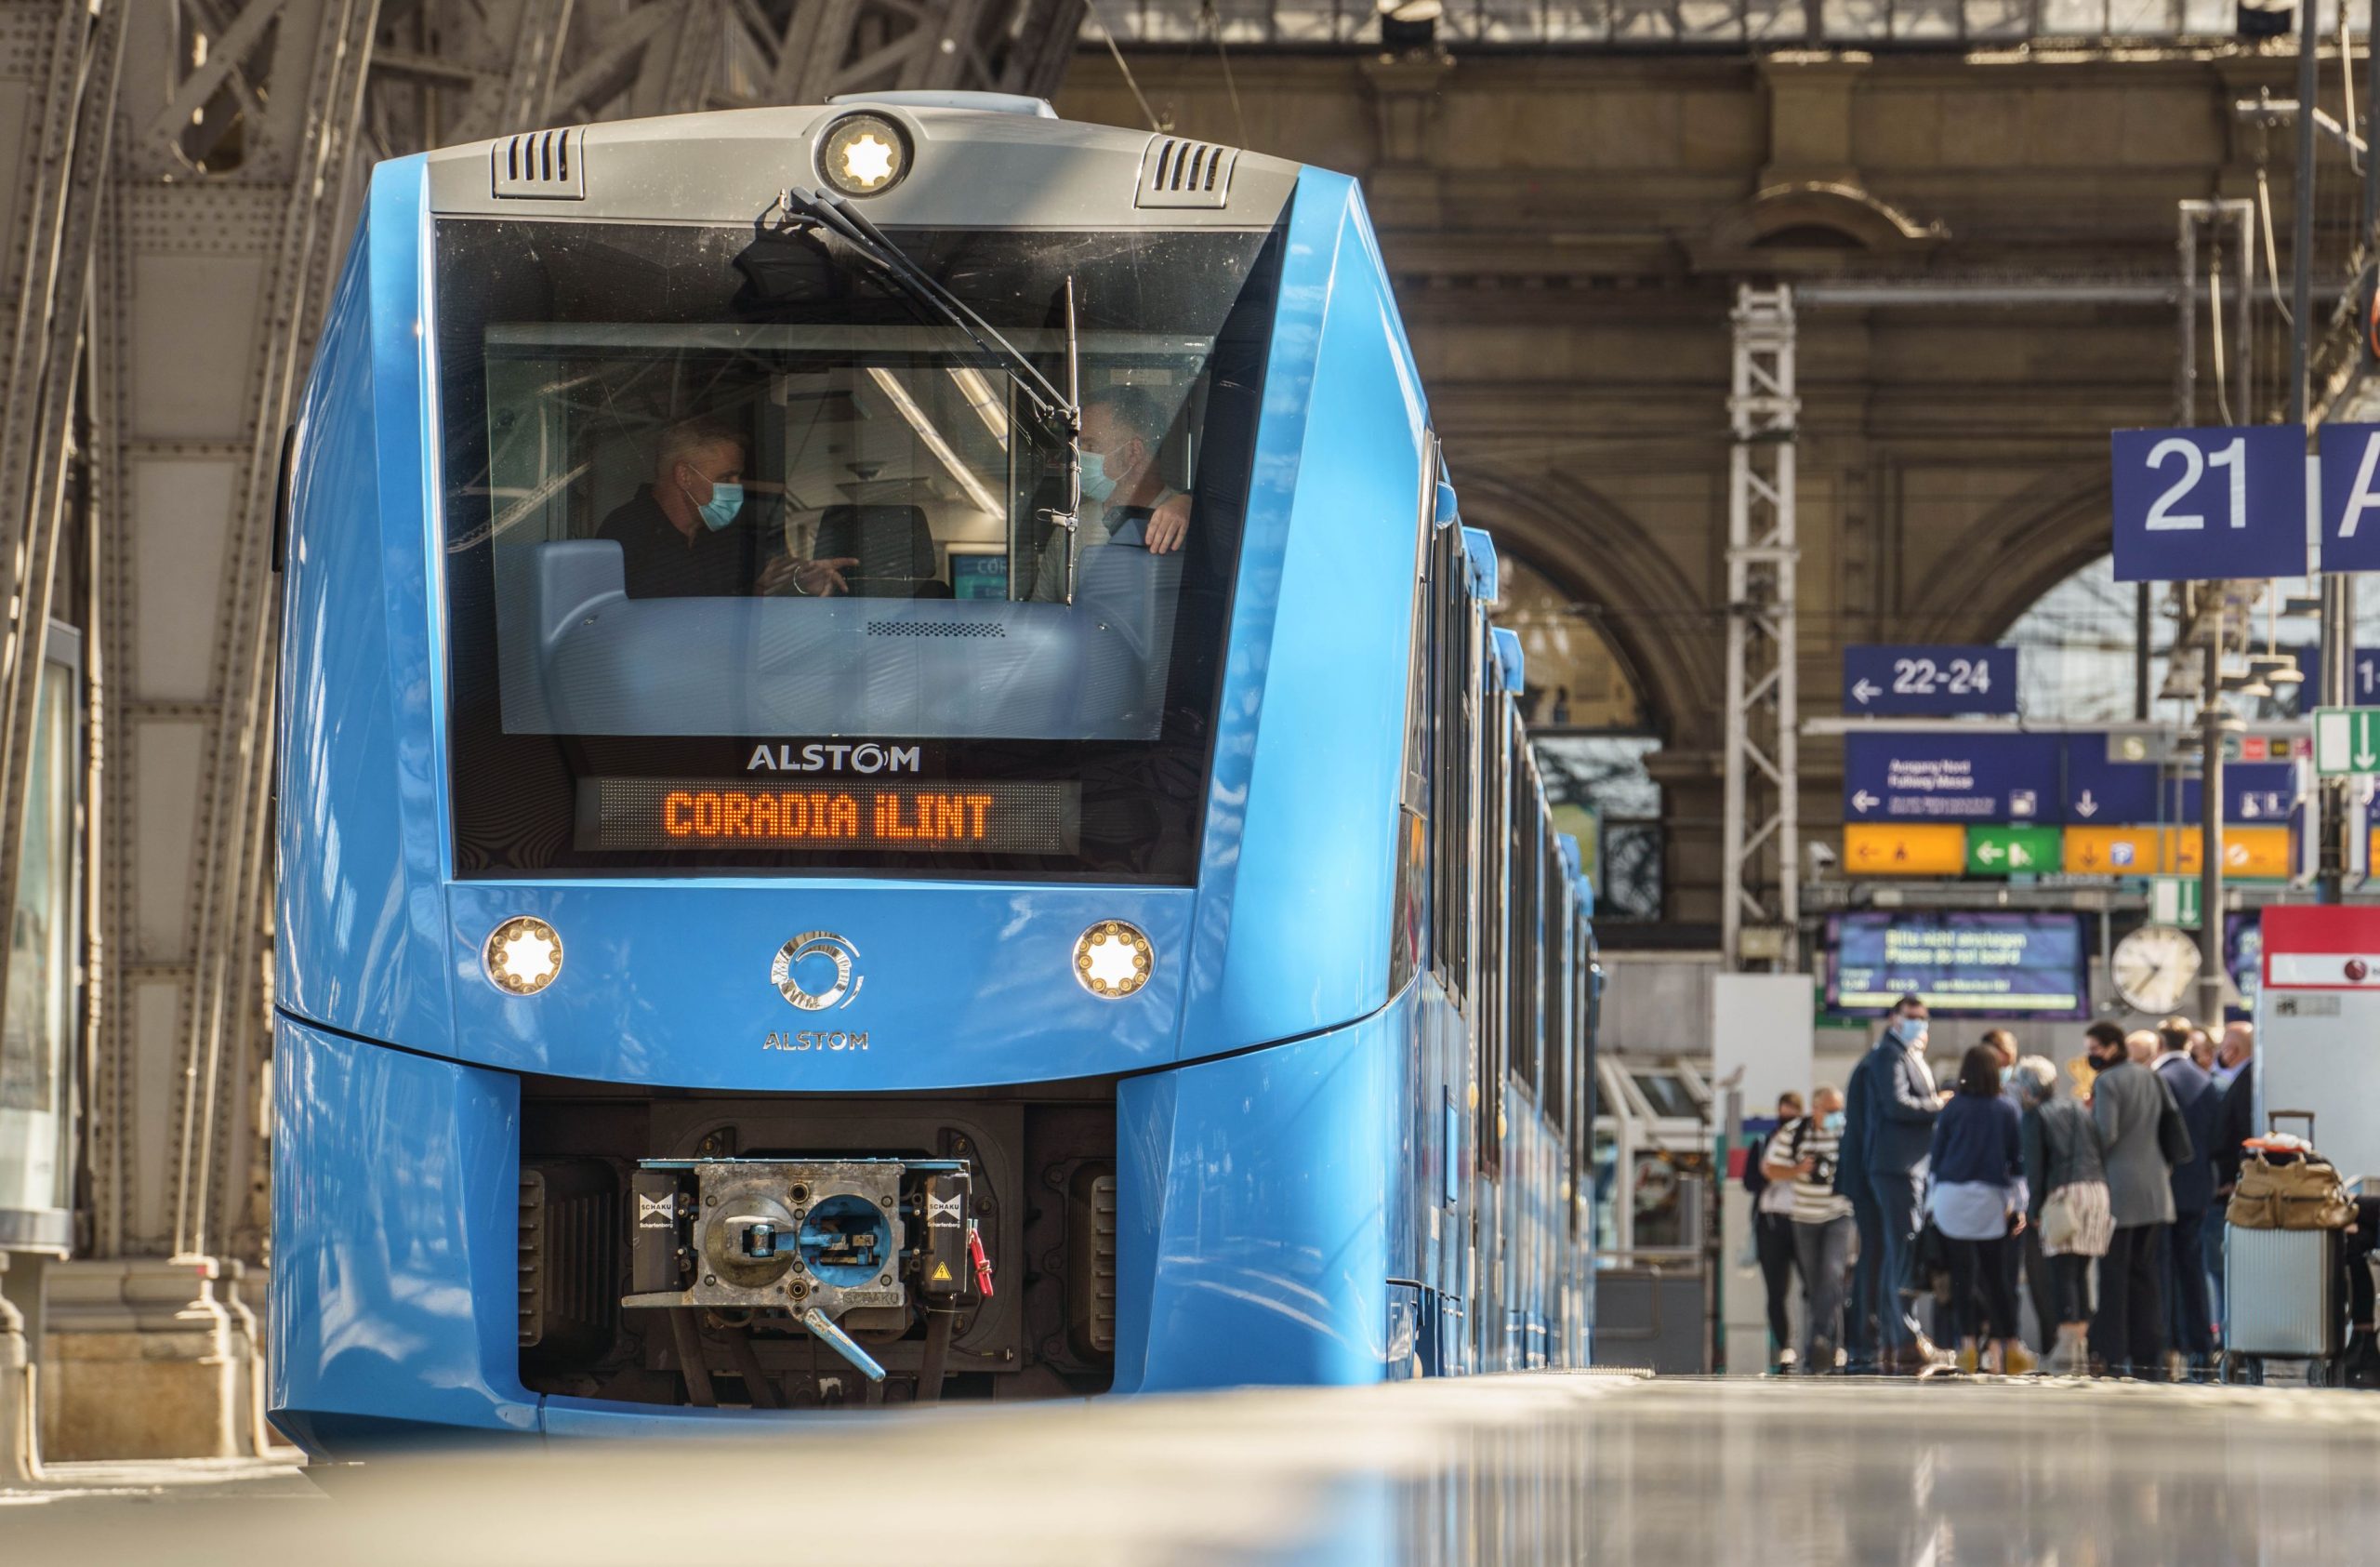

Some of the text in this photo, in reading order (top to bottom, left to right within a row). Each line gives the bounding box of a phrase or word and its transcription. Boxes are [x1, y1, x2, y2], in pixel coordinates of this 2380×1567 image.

[2145, 437, 2246, 531] 21
[1893, 657, 1991, 694] 22-24
[747, 743, 920, 774] ALSTOM
[664, 791, 857, 837] CORADIA
[762, 1031, 868, 1051] ALSTOM
